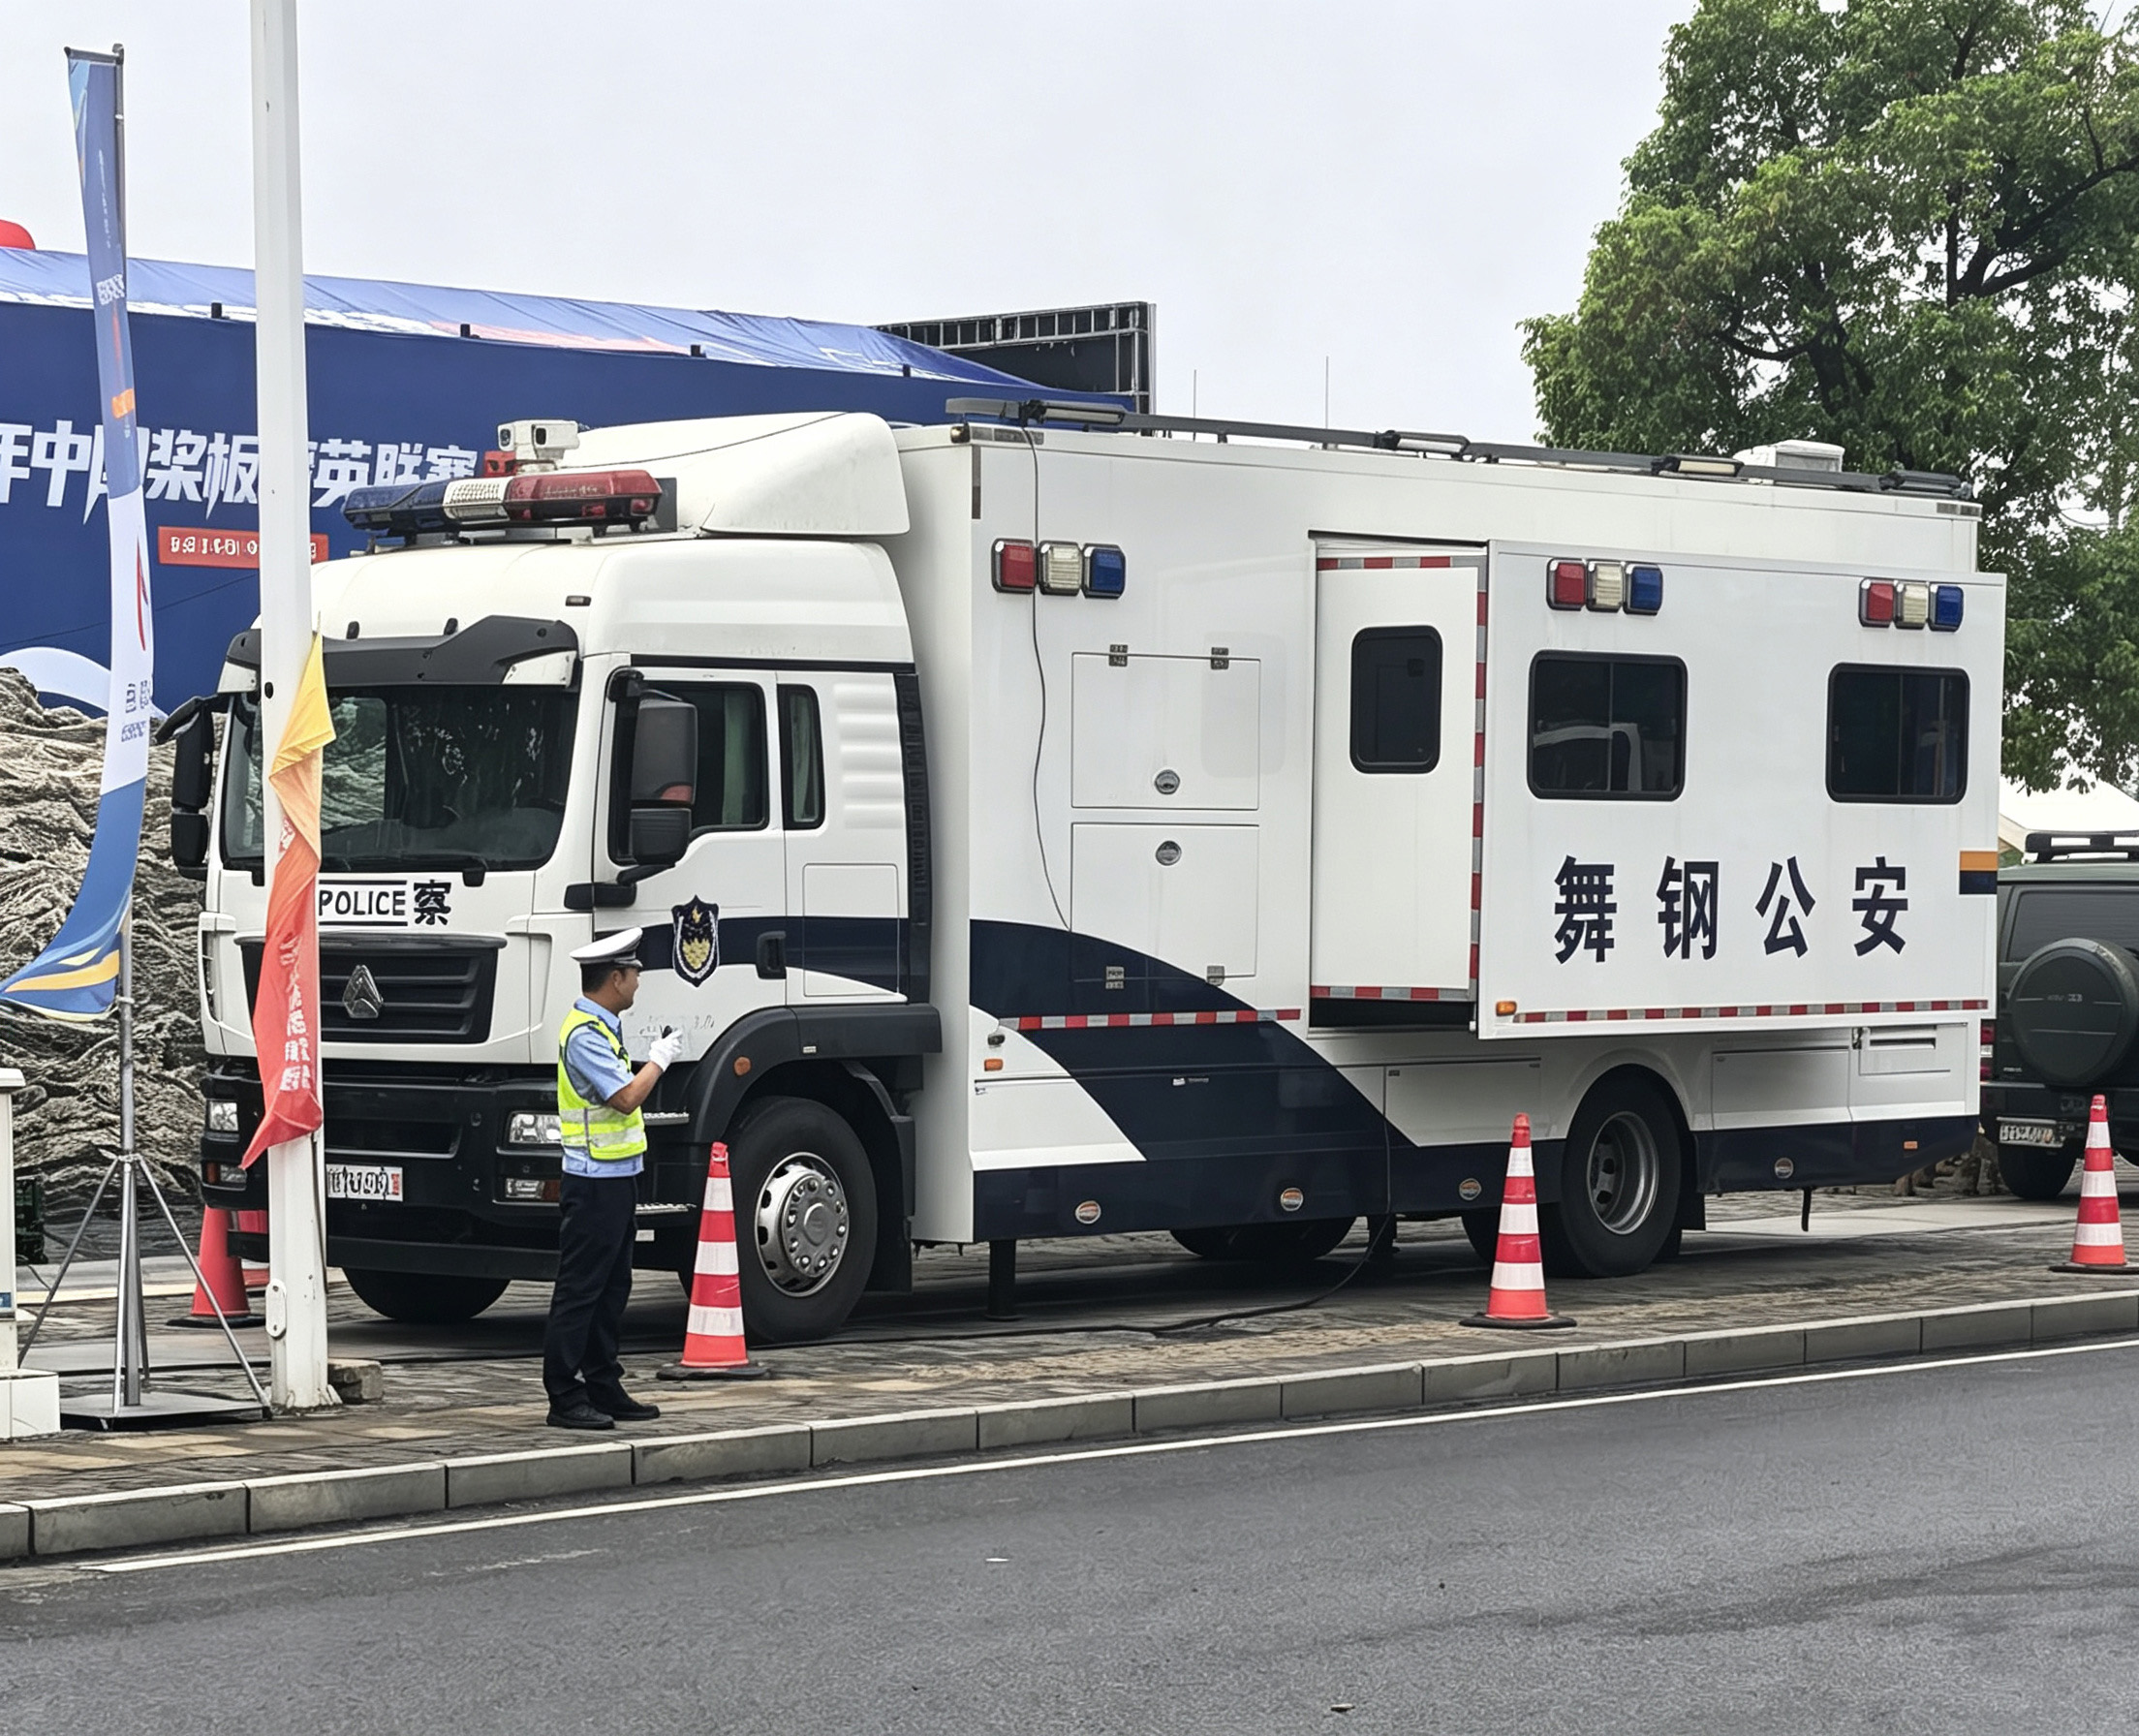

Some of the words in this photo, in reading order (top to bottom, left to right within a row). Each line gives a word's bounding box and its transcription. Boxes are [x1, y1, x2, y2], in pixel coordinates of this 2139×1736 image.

[319, 889, 406, 916] POLICE
[413, 879, 451, 926] 察
[1554, 854, 1908, 964] 舞钢公安
